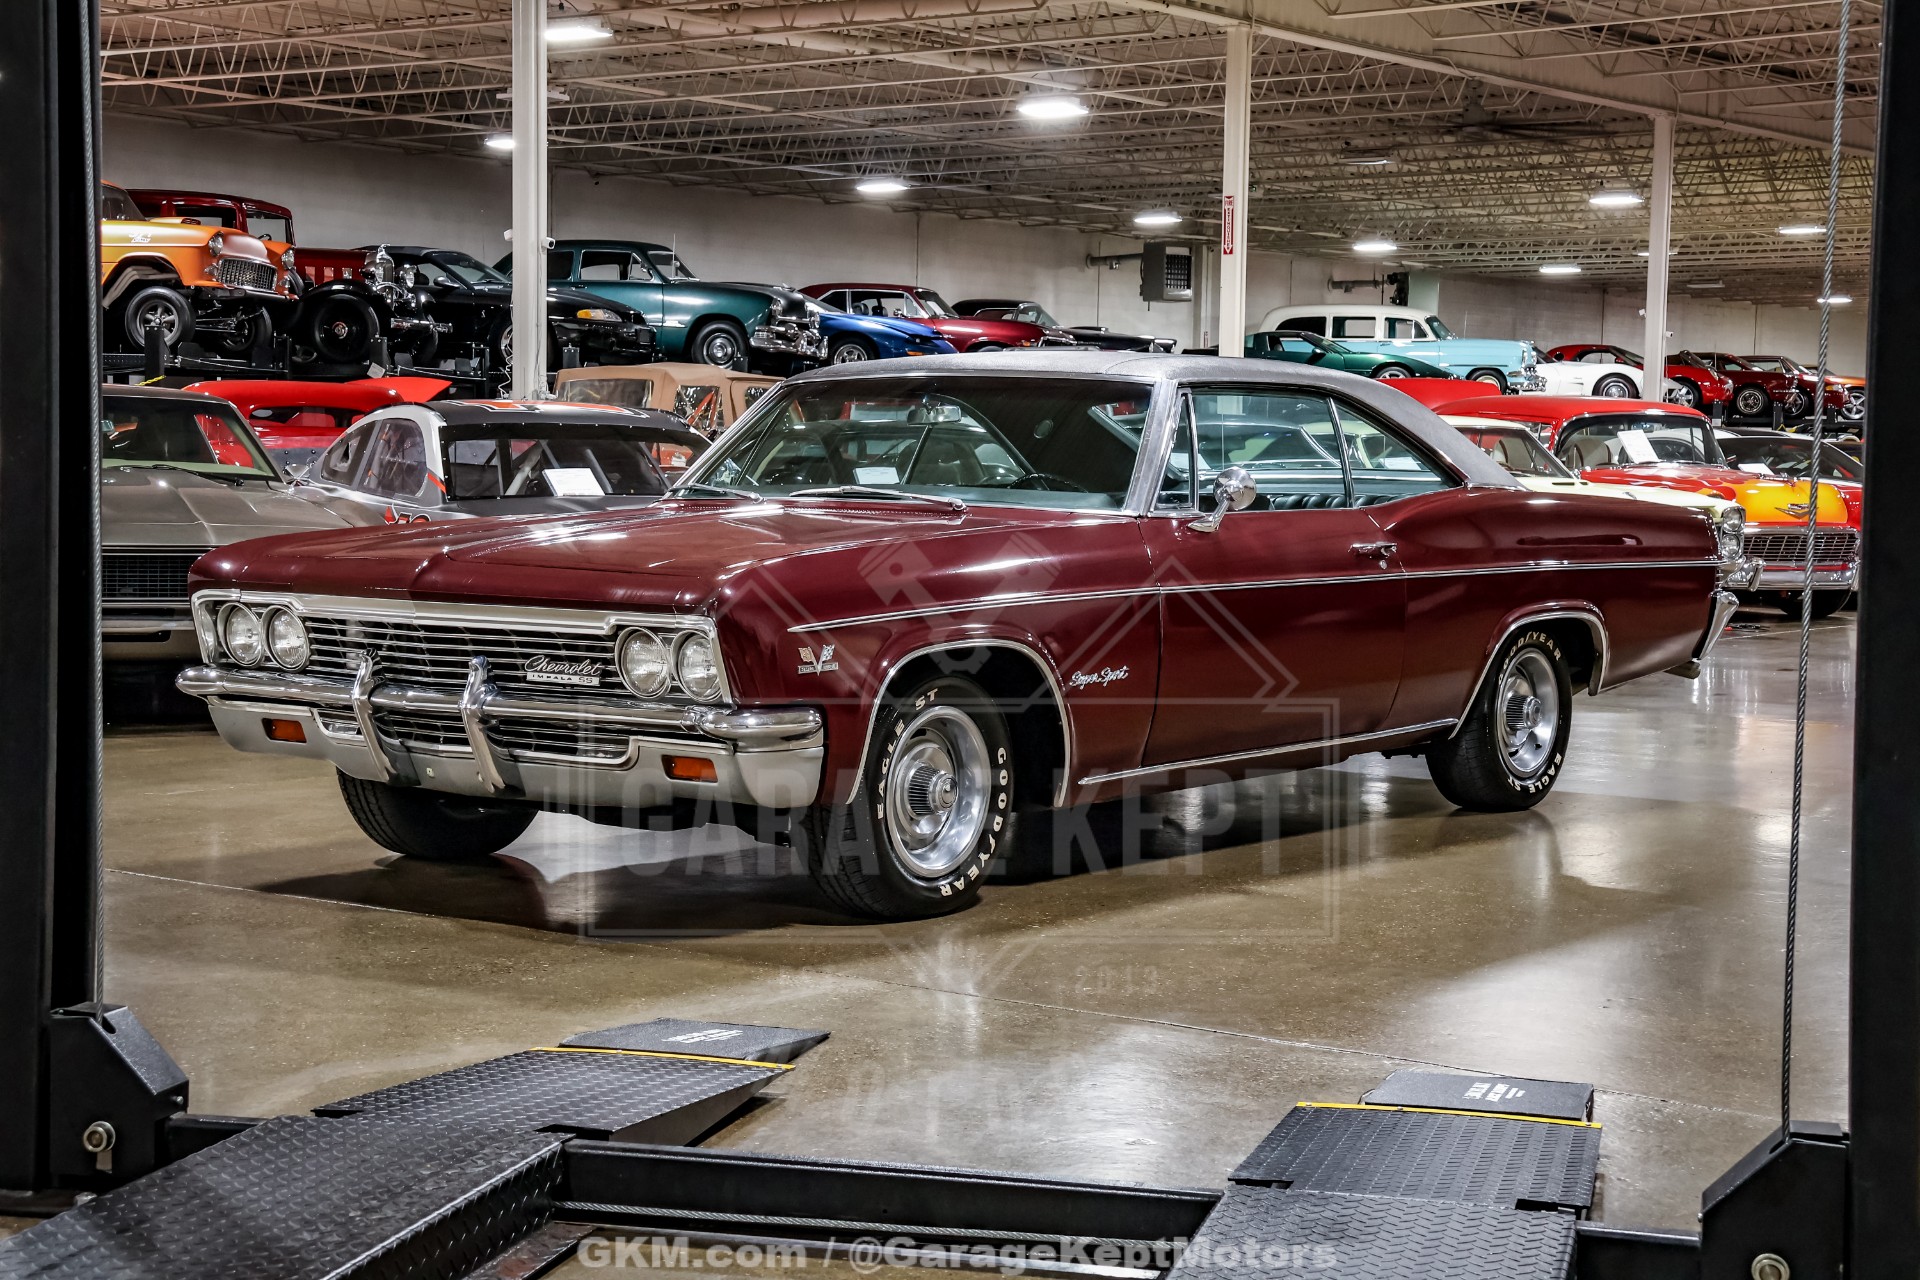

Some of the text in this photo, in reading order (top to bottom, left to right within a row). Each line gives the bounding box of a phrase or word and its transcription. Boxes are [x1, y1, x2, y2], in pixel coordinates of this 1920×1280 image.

[524, 655, 602, 676] Chevrolet
[579, 676, 593, 684] SS
[1069, 665, 1129, 690] Super Sport
[877, 688, 939, 820] EAGLE ST
[1528, 752, 1562, 794] EAGLE
[938, 747, 1009, 897] GOODYEAR
